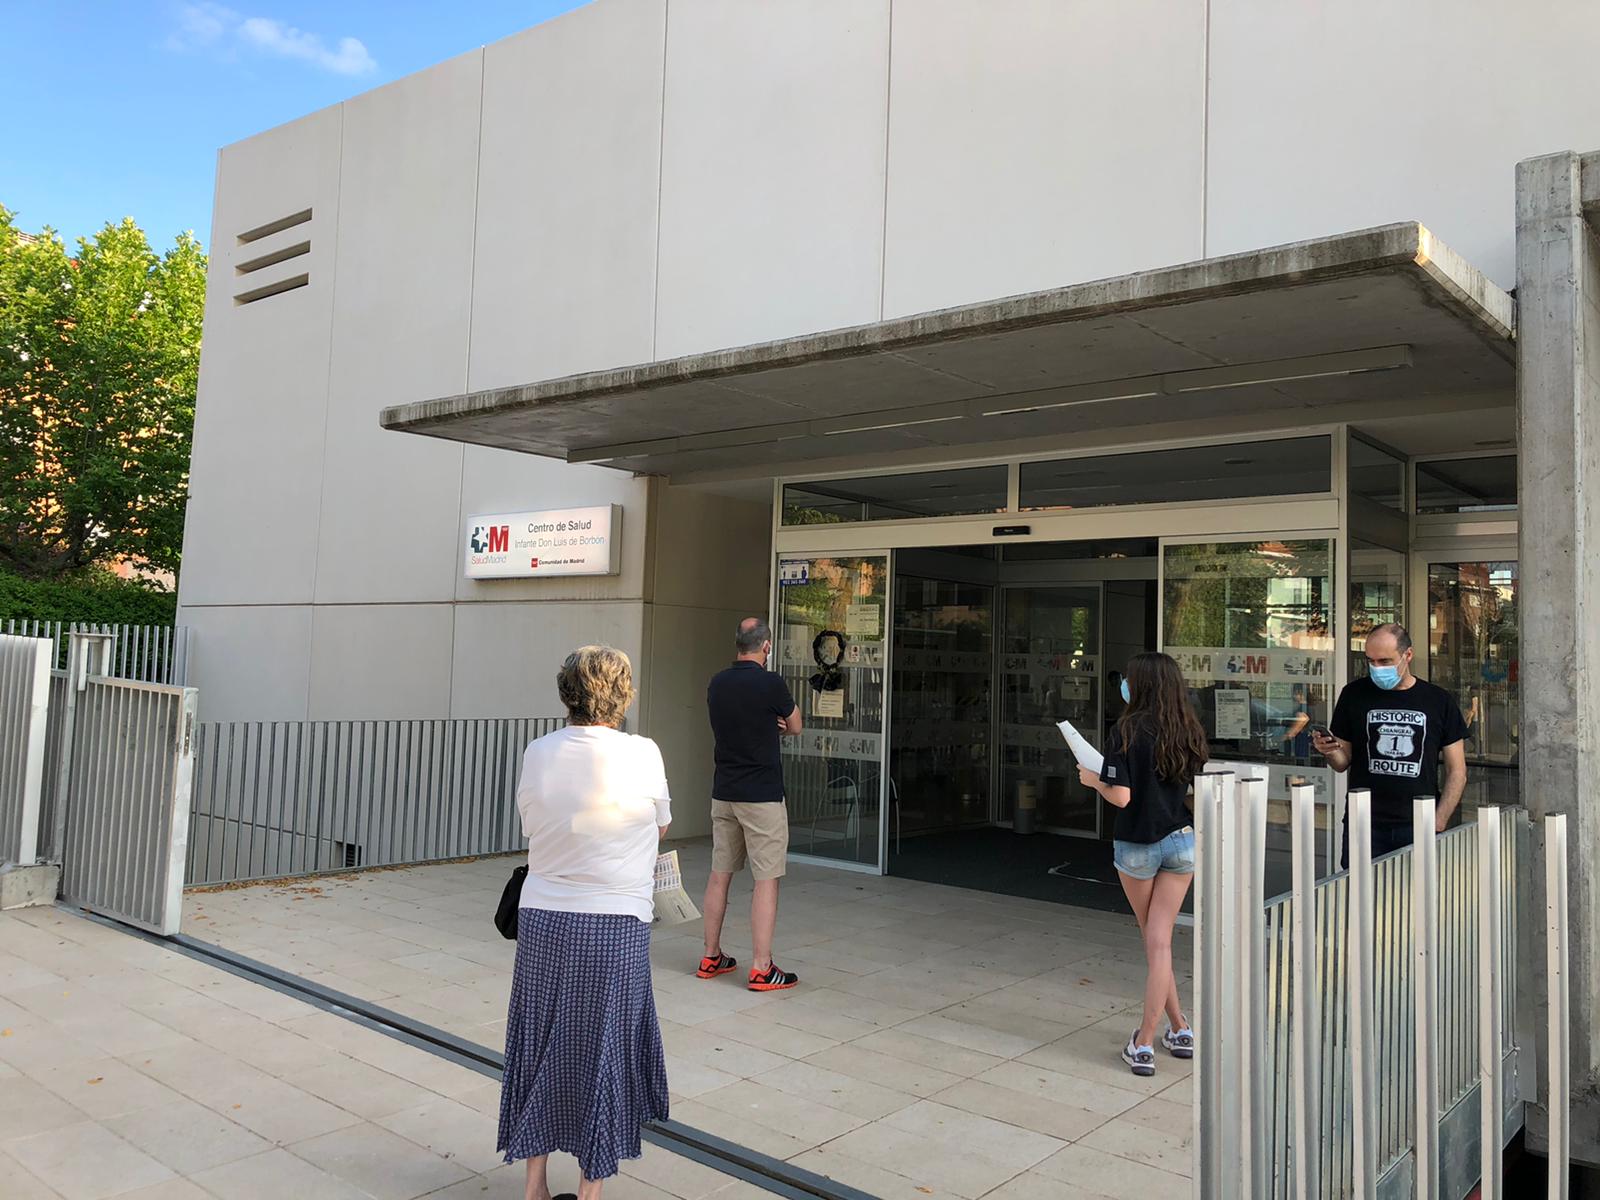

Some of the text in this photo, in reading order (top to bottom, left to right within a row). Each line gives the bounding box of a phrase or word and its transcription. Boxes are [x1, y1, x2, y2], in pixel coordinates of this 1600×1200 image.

[528, 520, 592, 533] Centro de Salud
[514, 538, 537, 549] Infante
[538, 537, 552, 548] Don
[553, 536, 567, 547] Luis
[569, 536, 578, 546] de
[538, 558, 562, 566] Comunidad
[1246, 655, 1268, 675] M
[1371, 712, 1421, 724] HISTORIC
[1391, 736, 1399, 751] 1
[1373, 760, 1415, 774] ROUTE
